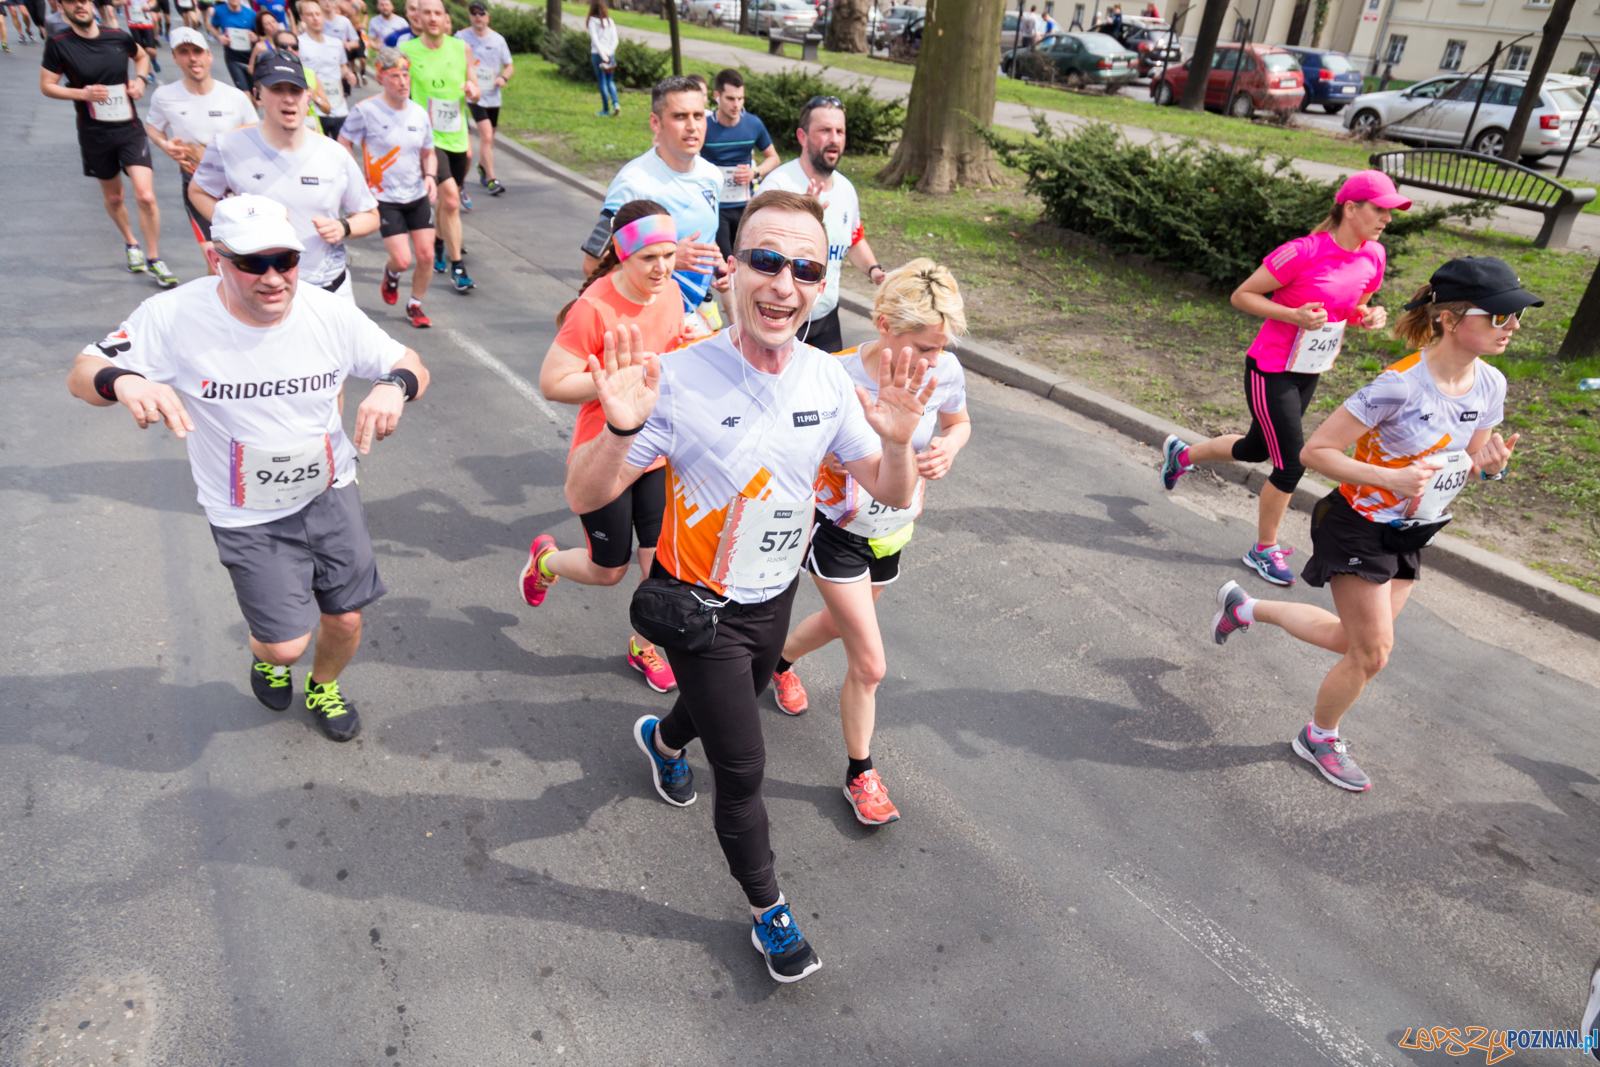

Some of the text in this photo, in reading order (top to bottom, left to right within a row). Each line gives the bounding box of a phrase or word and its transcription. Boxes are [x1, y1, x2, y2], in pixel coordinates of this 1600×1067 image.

[1308, 338, 1339, 351] 2419
[201, 369, 340, 400] BRIDGESTONE
[721, 416, 741, 427] 4F
[256, 462, 320, 485] 9425
[1433, 469, 1467, 491] 4633
[759, 527, 802, 552] 572
[767, 555, 787, 563] Radek
